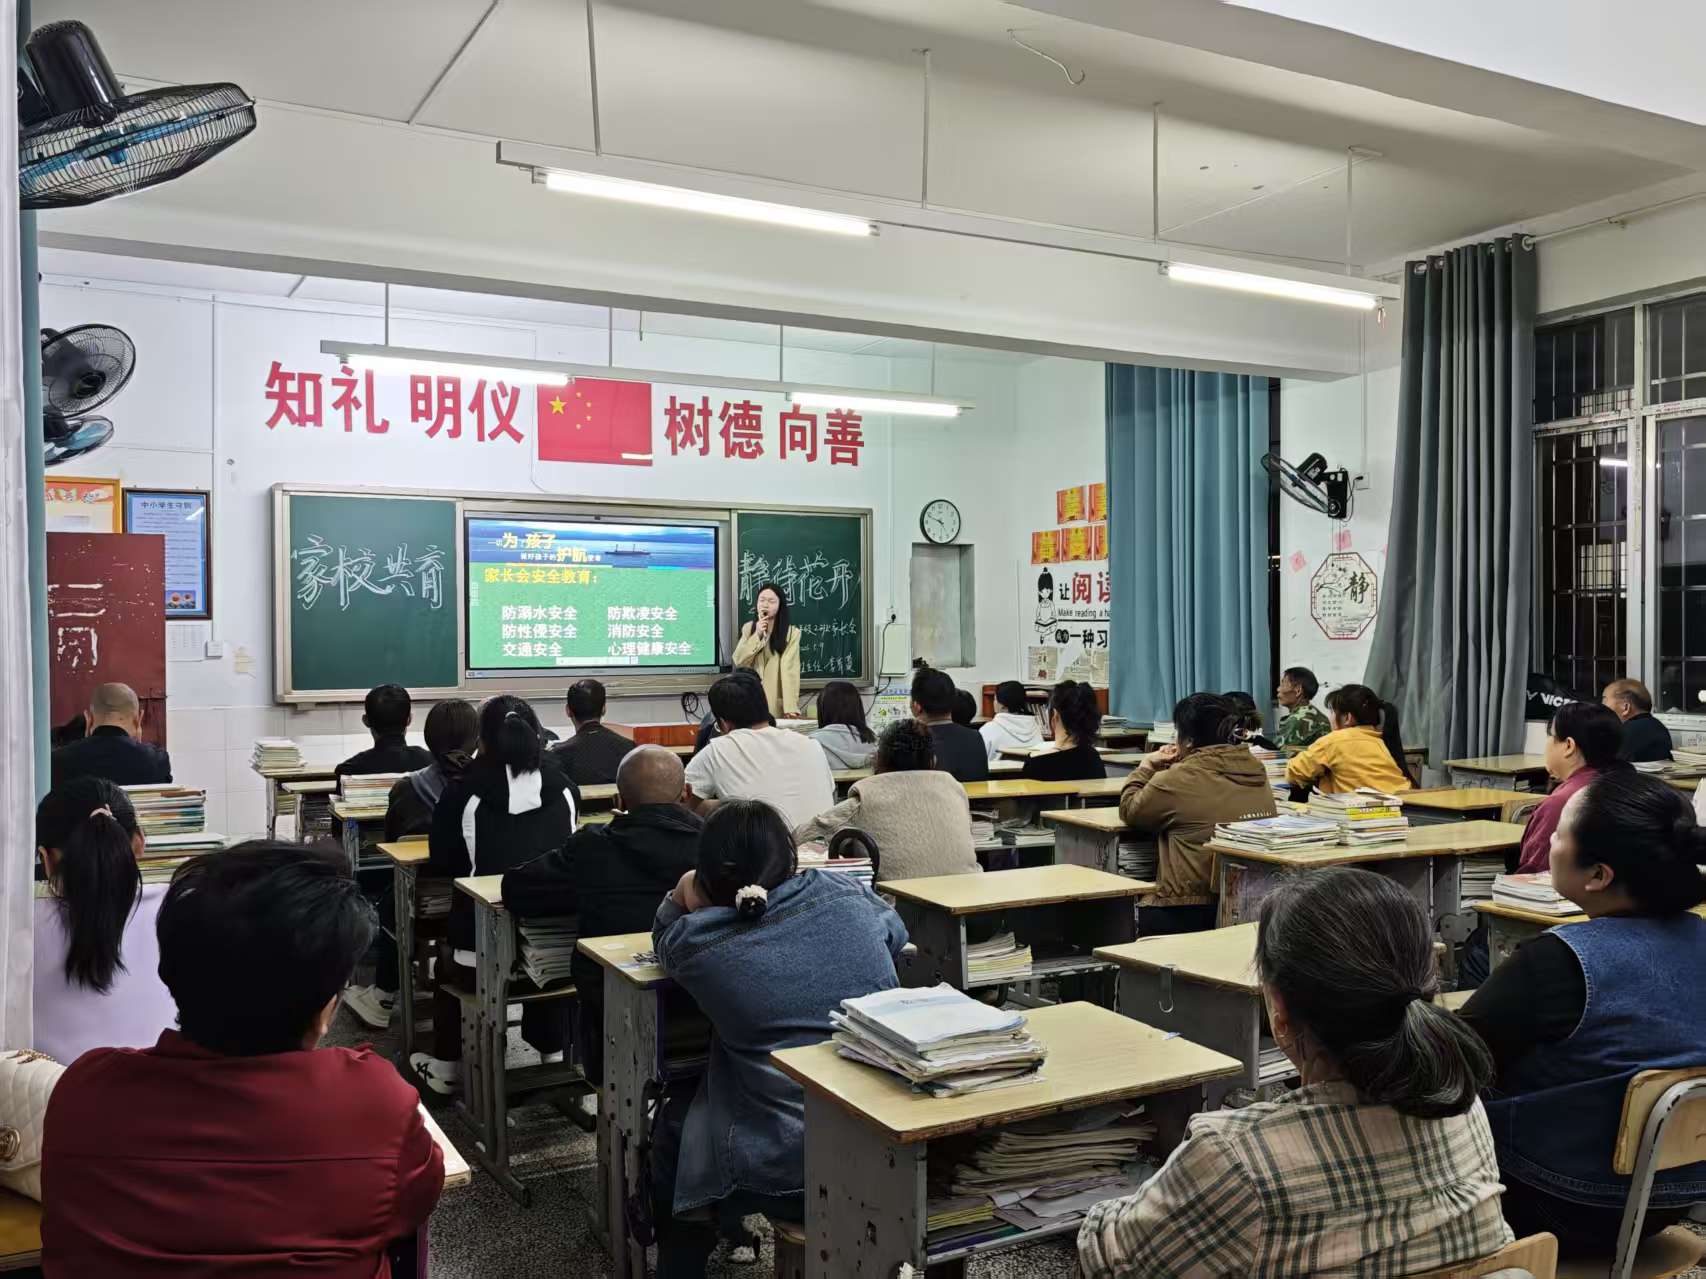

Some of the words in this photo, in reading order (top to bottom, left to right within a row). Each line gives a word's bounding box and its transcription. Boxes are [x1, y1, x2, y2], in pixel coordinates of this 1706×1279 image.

[265, 361, 390, 433] 知礼
[410, 374, 525, 443] 明仪
[664, 396, 764, 459] 树德
[779, 402, 865, 467] 向善
[290, 533, 445, 611] 家校共育
[738, 550, 854, 611] 静待花开
[1344, 571, 1370, 604] 静
[502, 605, 578, 621] 防溺水安全
[607, 606, 679, 621] 防欺凌安全
[1058, 608, 1073, 617] Make
[1075, 608, 1097, 619] reading
[502, 623, 578, 639] 防性侵安全
[607, 624, 665, 639] 消防安全
[502, 642, 564, 657] 交通安全
[607, 641, 693, 656] 心理健康安全
